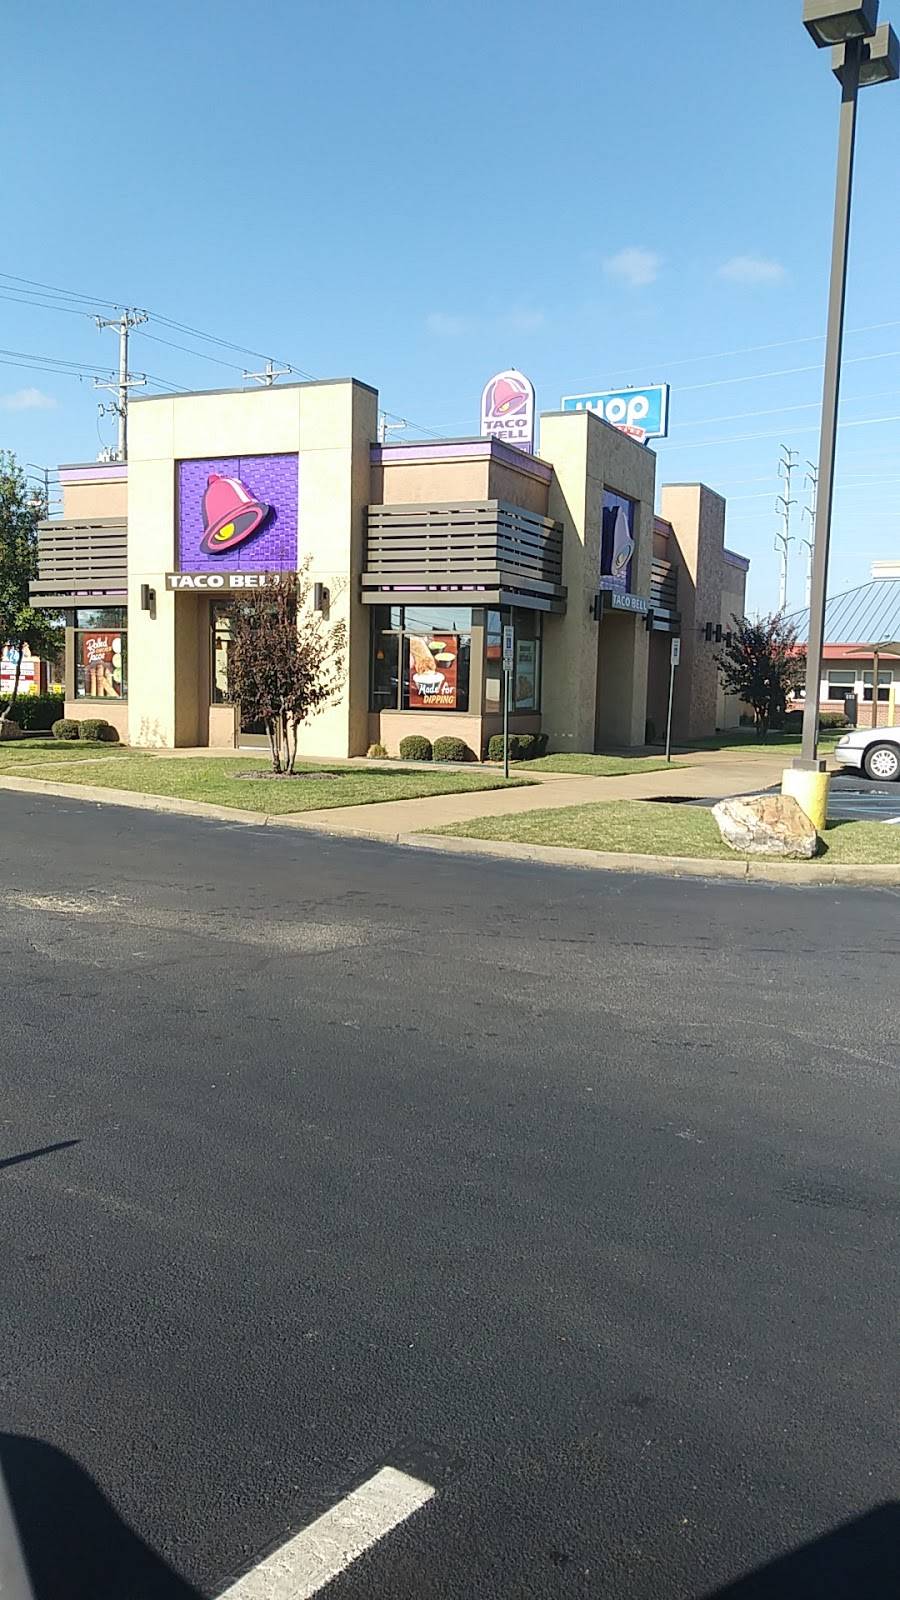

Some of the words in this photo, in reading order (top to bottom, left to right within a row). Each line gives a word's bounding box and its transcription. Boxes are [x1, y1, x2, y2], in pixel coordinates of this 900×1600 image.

[484, 419, 528, 430] TACO
[168, 575, 225, 588] TACO
[612, 594, 631, 607] TACO
[631, 598, 647, 611] BELL
[418, 682, 440, 695] Made
[441, 681, 455, 695] for
[423, 695, 454, 704] DIPPING
